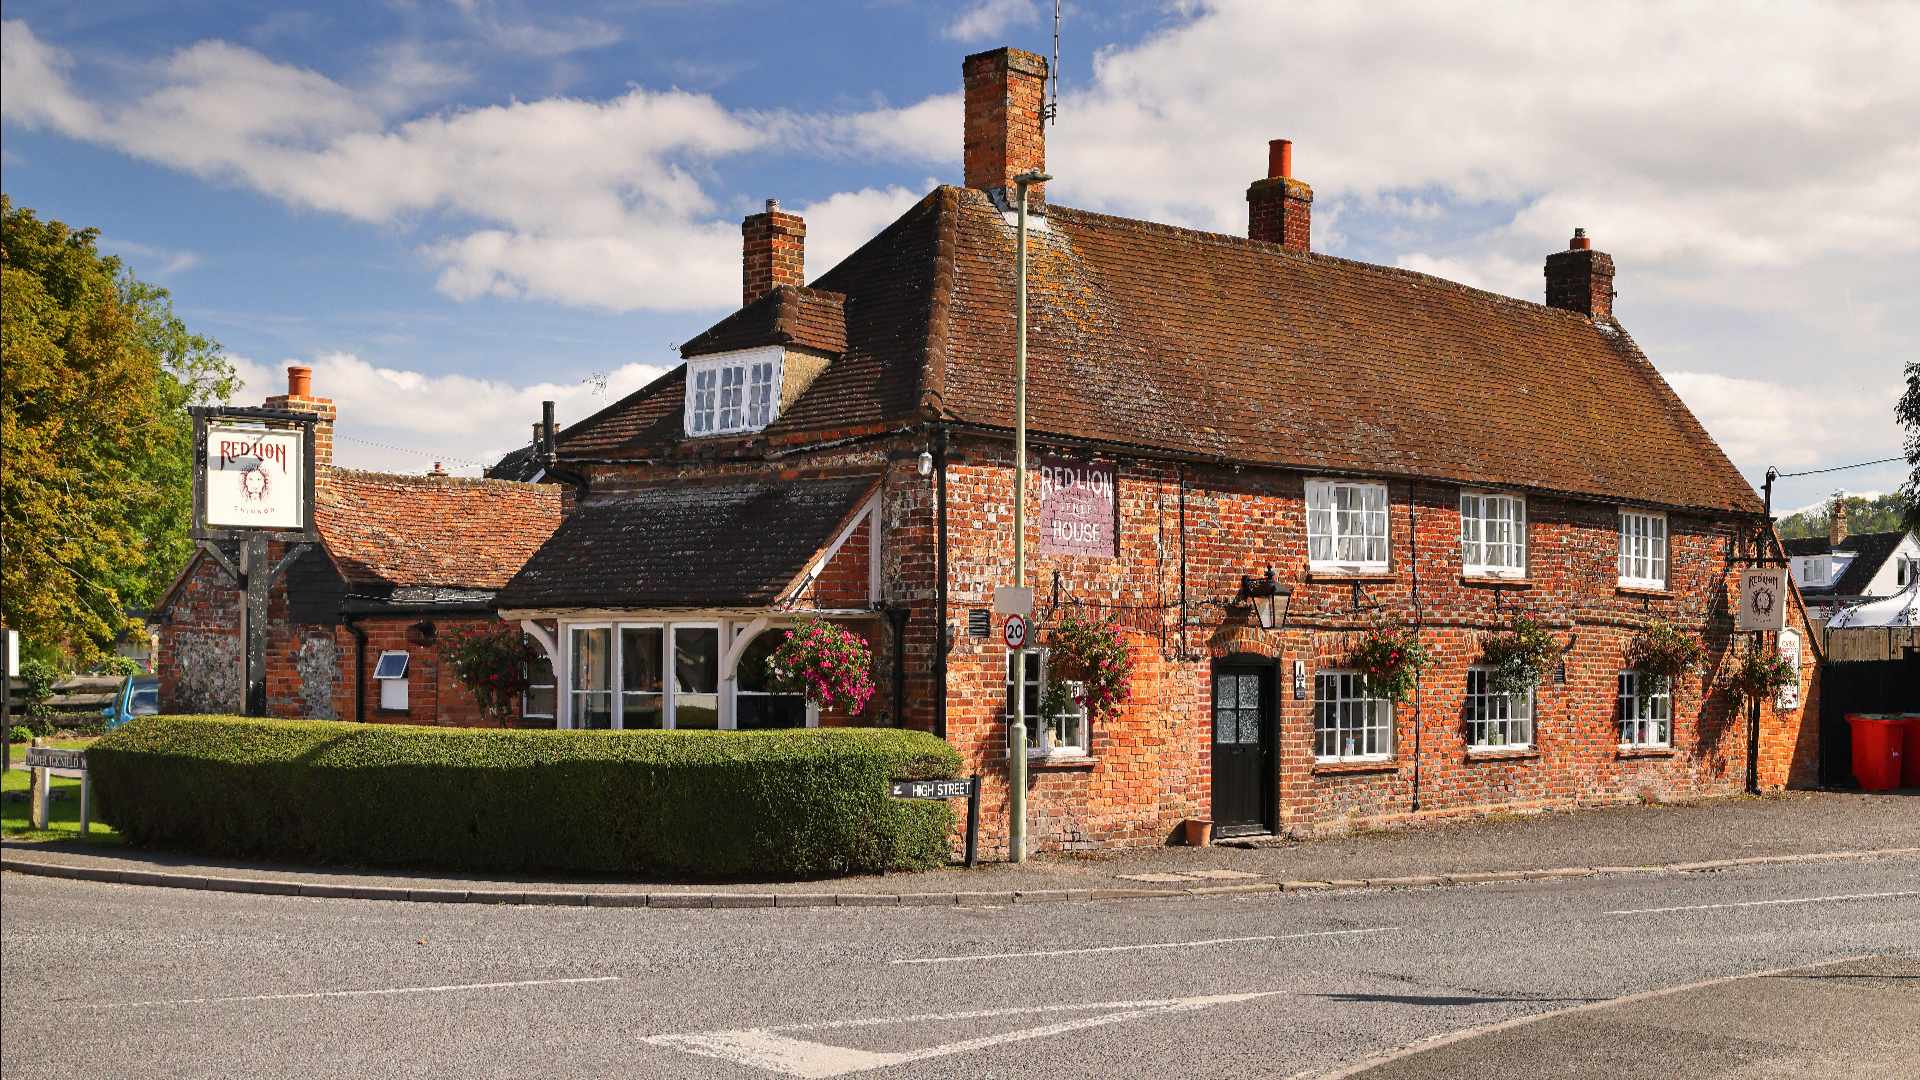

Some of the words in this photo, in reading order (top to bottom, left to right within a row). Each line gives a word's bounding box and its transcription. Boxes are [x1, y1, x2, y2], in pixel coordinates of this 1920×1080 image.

[220, 441, 249, 471] RED
[251, 442, 287, 474] LION
[1041, 465, 1074, 500] RED
[1076, 469, 1113, 507] LION
[1053, 520, 1101, 542] HOUSE
[1007, 624, 1023, 639] 20
[912, 784, 934, 797] HIGH
[937, 782, 971, 796] STREET
